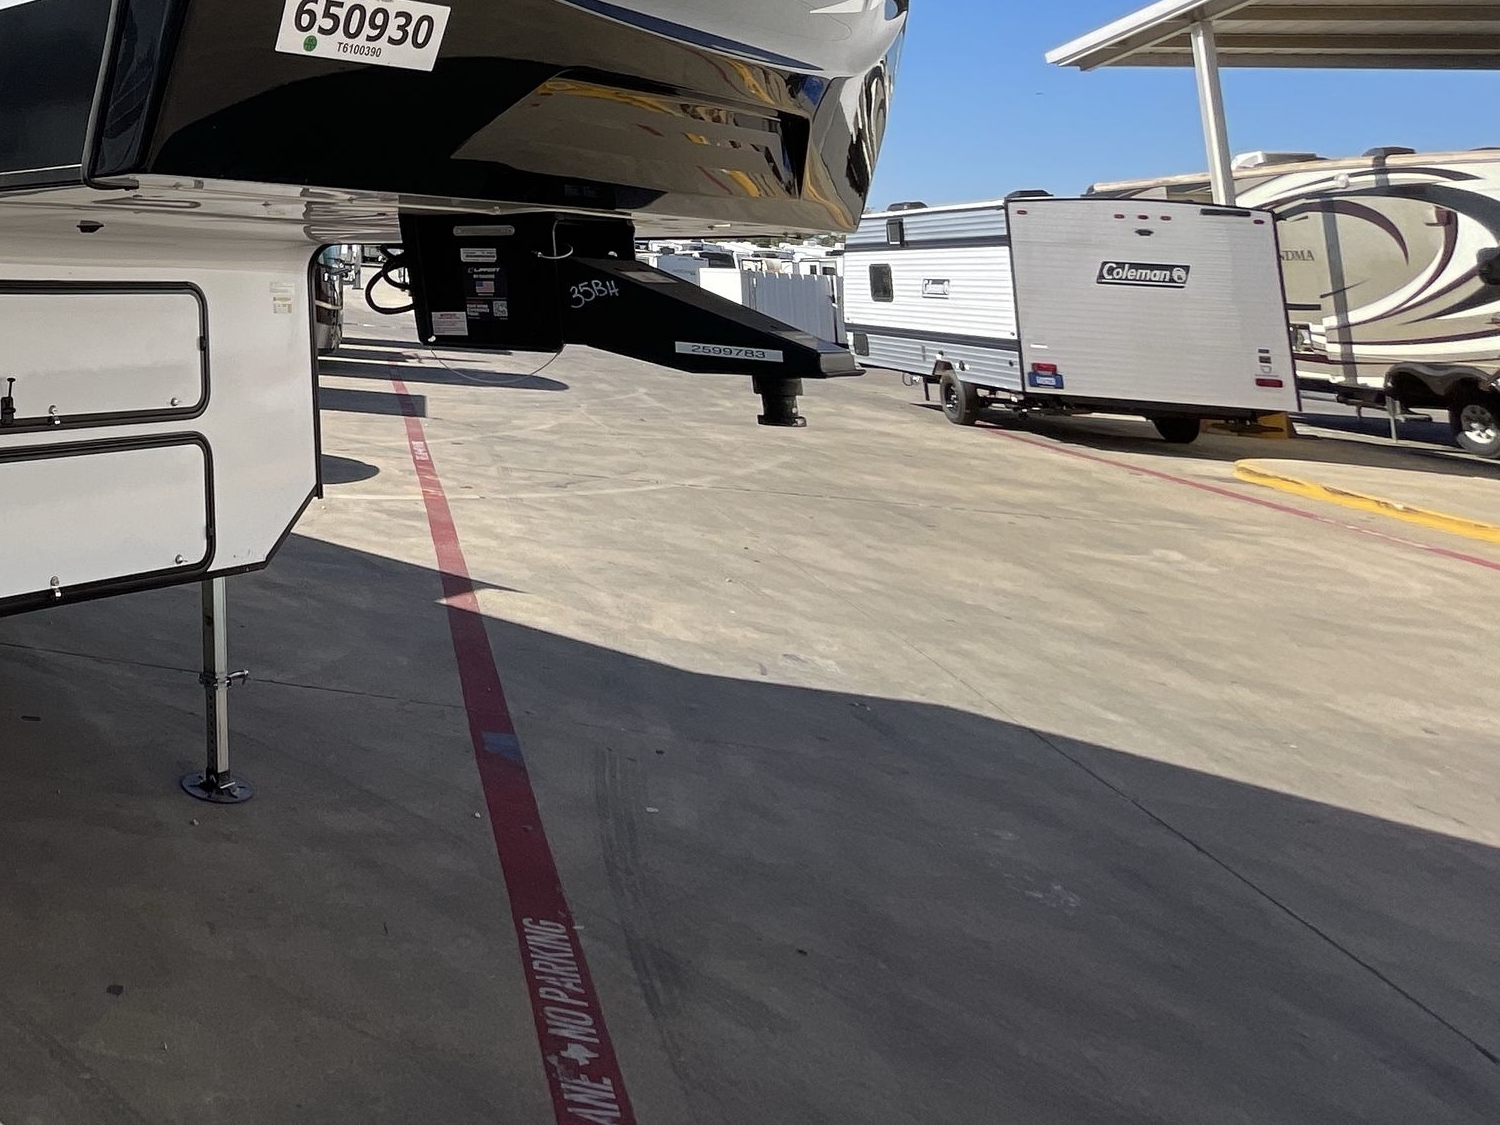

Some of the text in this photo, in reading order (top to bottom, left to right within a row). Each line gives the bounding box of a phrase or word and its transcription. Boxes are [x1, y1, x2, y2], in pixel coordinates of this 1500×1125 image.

[337, 41, 382, 58] T6100390
[1102, 263, 1170, 281] Coleman
[570, 280, 619, 308] 35BH
[691, 344, 766, 359] 2599783
[522, 917, 590, 1007] PARKING
[543, 1006, 600, 1044] NO
